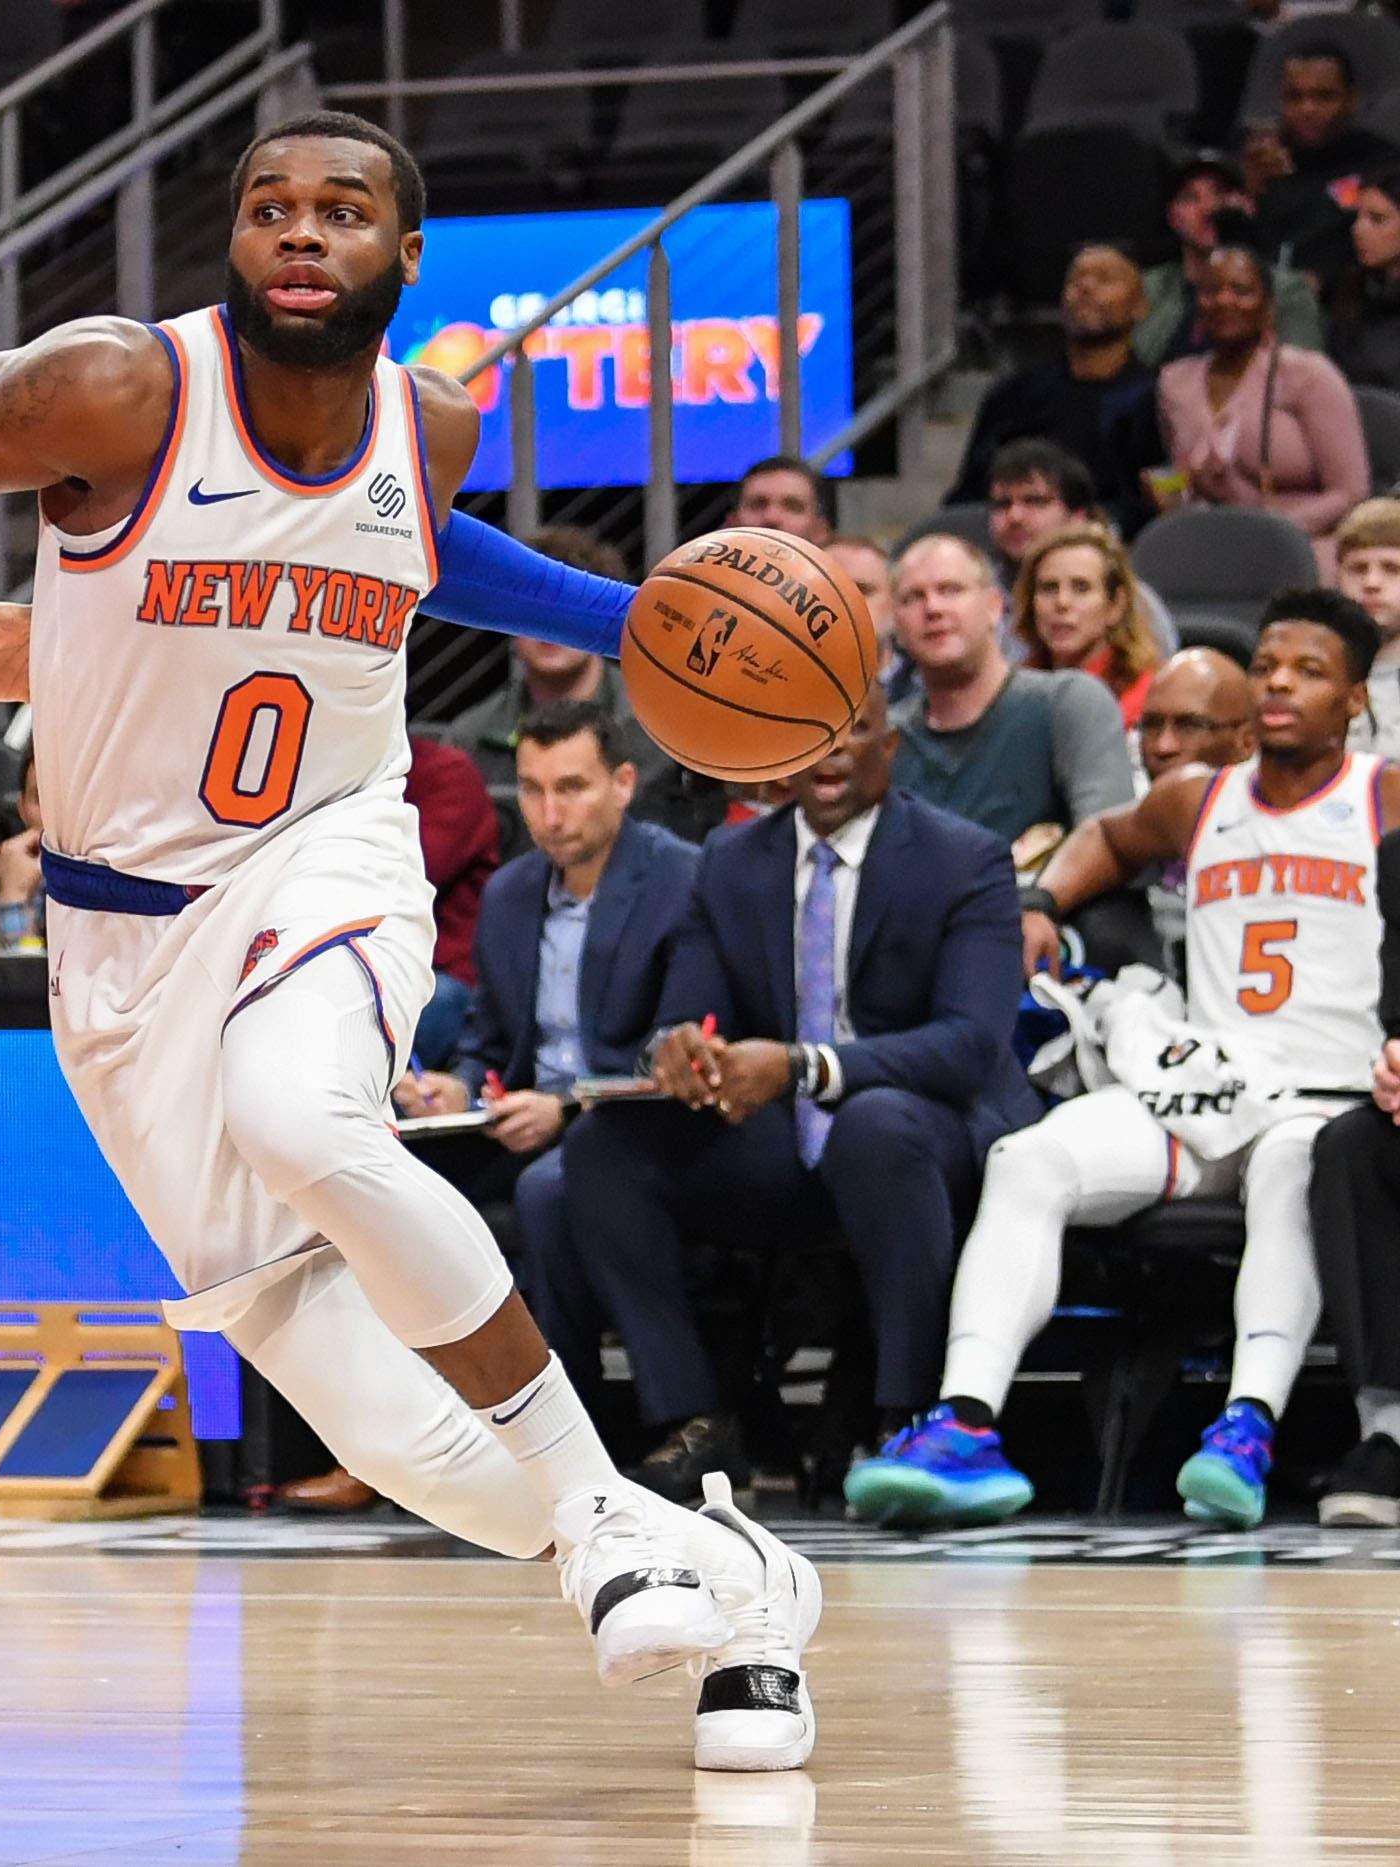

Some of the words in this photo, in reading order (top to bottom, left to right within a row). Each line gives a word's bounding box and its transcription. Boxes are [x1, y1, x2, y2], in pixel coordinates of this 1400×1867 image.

[355, 522, 413, 539] SQUARESPACE
[136, 558, 285, 630] NEW
[286, 561, 420, 654] YORK
[197, 670, 314, 829] 0
[1192, 855, 1266, 909] NEW
[1267, 854, 1367, 908] YORK
[1236, 919, 1298, 1016] 5
